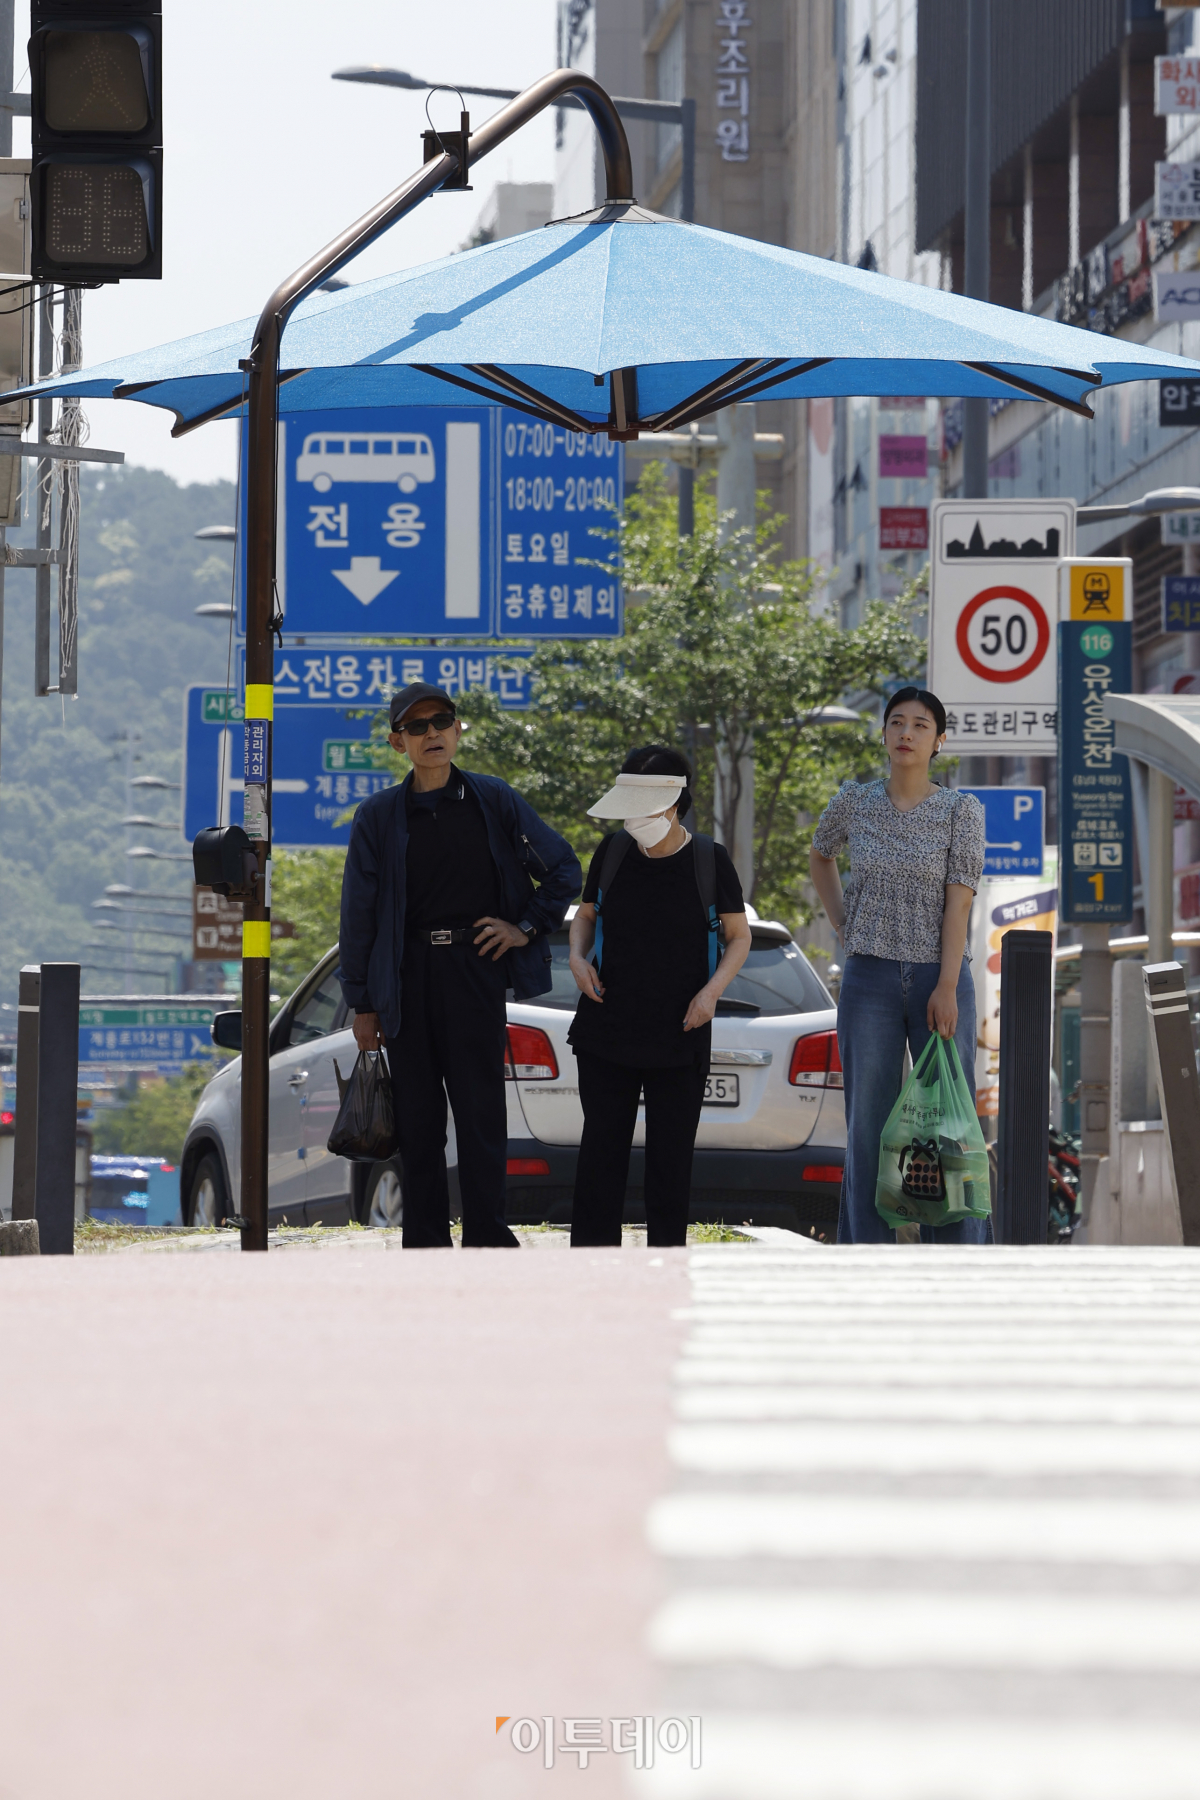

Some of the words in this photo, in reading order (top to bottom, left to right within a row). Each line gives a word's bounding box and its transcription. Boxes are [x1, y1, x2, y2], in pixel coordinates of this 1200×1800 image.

[715, 0, 752, 161] 후조리원
[1174, 86, 1200, 110] 외
[505, 476, 615, 511] 18:00-20:00
[505, 531, 569, 565] 토요일
[504, 584, 615, 619] 공휴일제외
[980, 614, 1027, 656] 50
[1082, 634, 1112, 651] 116
[274, 656, 425, 698] 스전용차로
[437, 656, 545, 699] 위반단
[252, 726, 264, 776] 관리자외
[1014, 796, 1034, 821] P
[1087, 872, 1104, 901] 1
[1002, 899, 1038, 920] 먹거리
